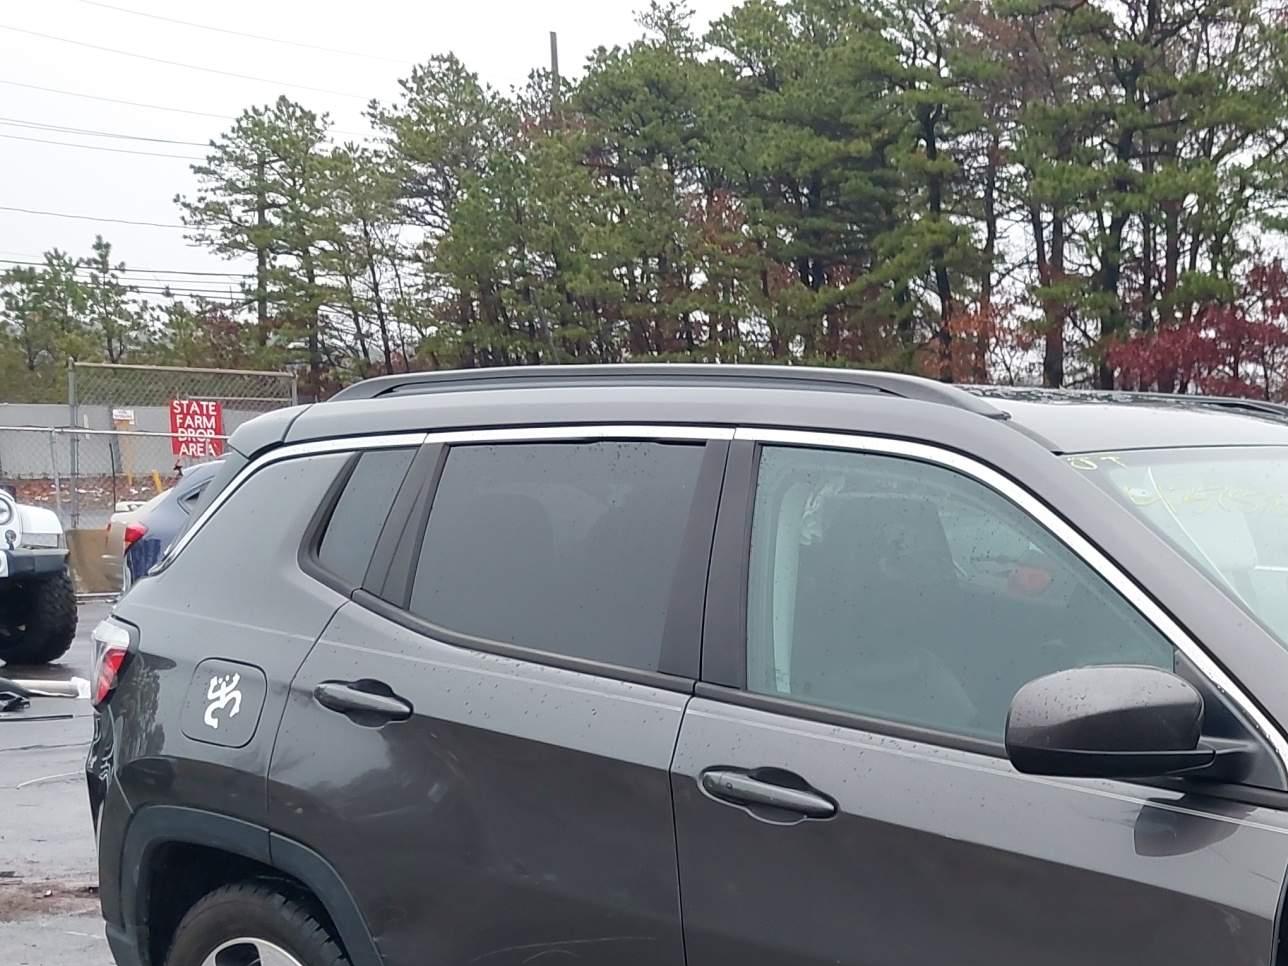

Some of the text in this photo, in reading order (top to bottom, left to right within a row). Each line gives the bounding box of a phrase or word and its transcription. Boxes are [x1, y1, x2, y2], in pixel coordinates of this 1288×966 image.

[173, 400, 216, 414] STATE
[176, 414, 216, 428] FARM
[177, 428, 216, 442] DROP
[179, 442, 216, 456] AREA
